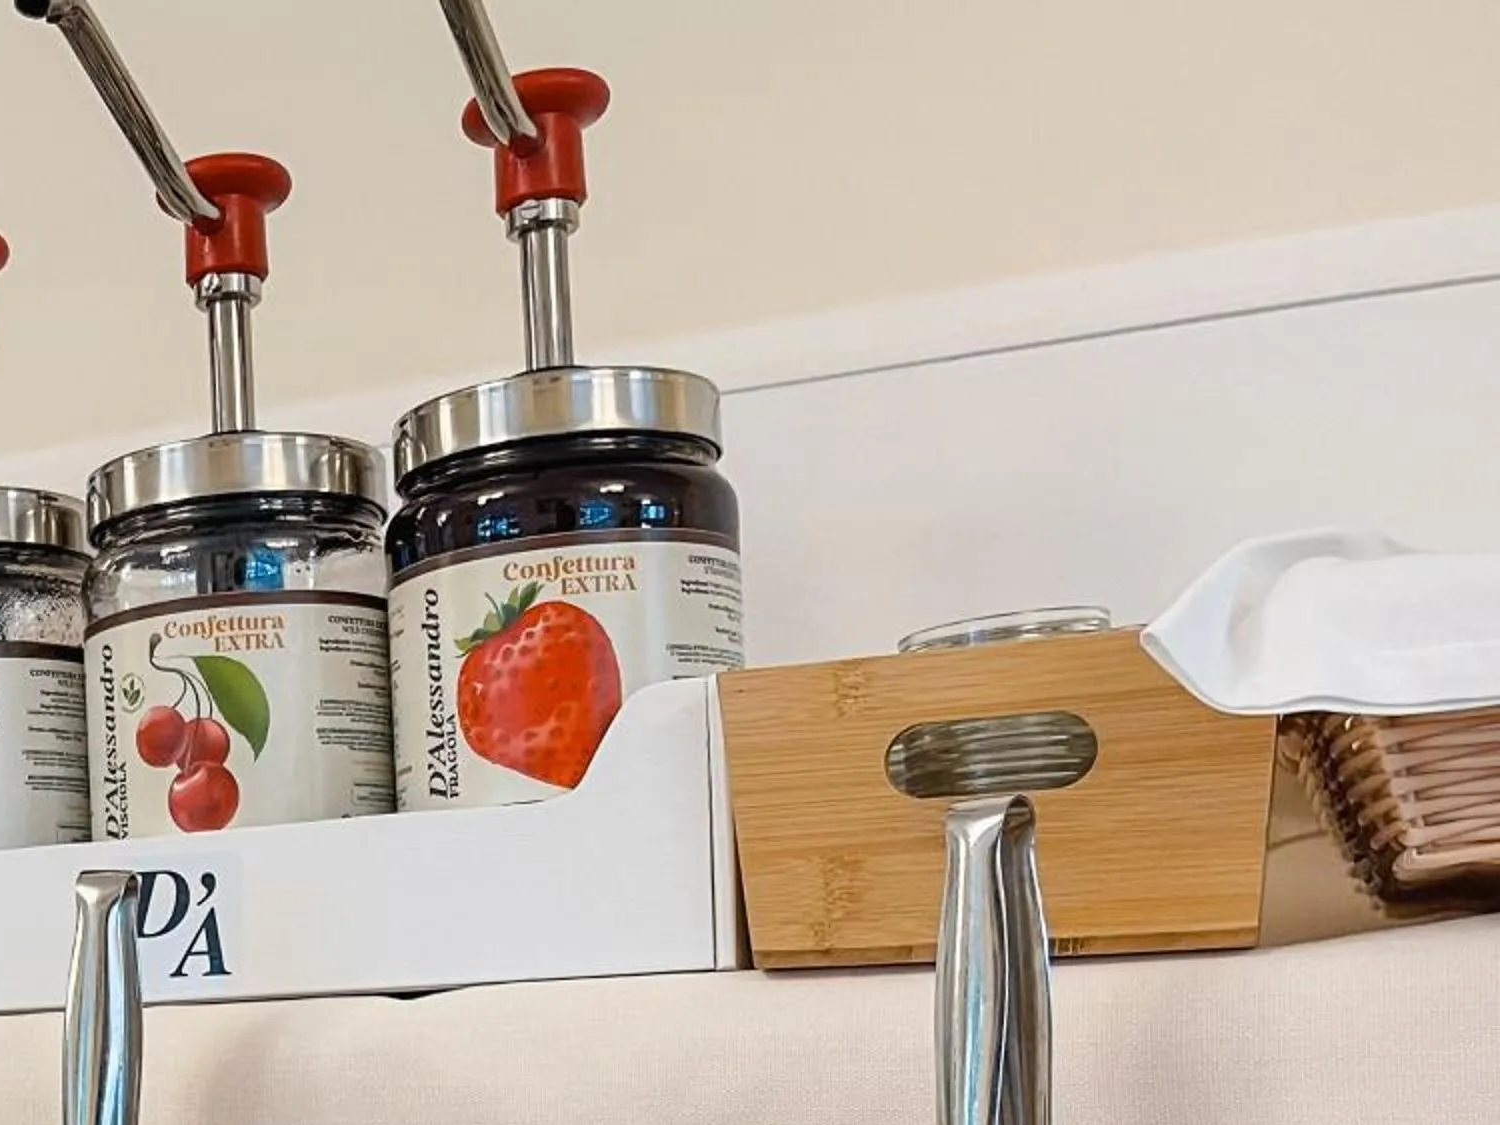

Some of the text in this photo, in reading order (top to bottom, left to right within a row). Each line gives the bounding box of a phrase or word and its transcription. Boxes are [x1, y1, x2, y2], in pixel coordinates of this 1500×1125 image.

[502, 553, 637, 582] Confettura
[560, 573, 639, 597] EXTRA
[163, 613, 287, 640] Confettura
[214, 632, 286, 653] EXTRA
[446, 713, 460, 799] FRAGOLA
[119, 762, 130, 840] VISCIOLA
